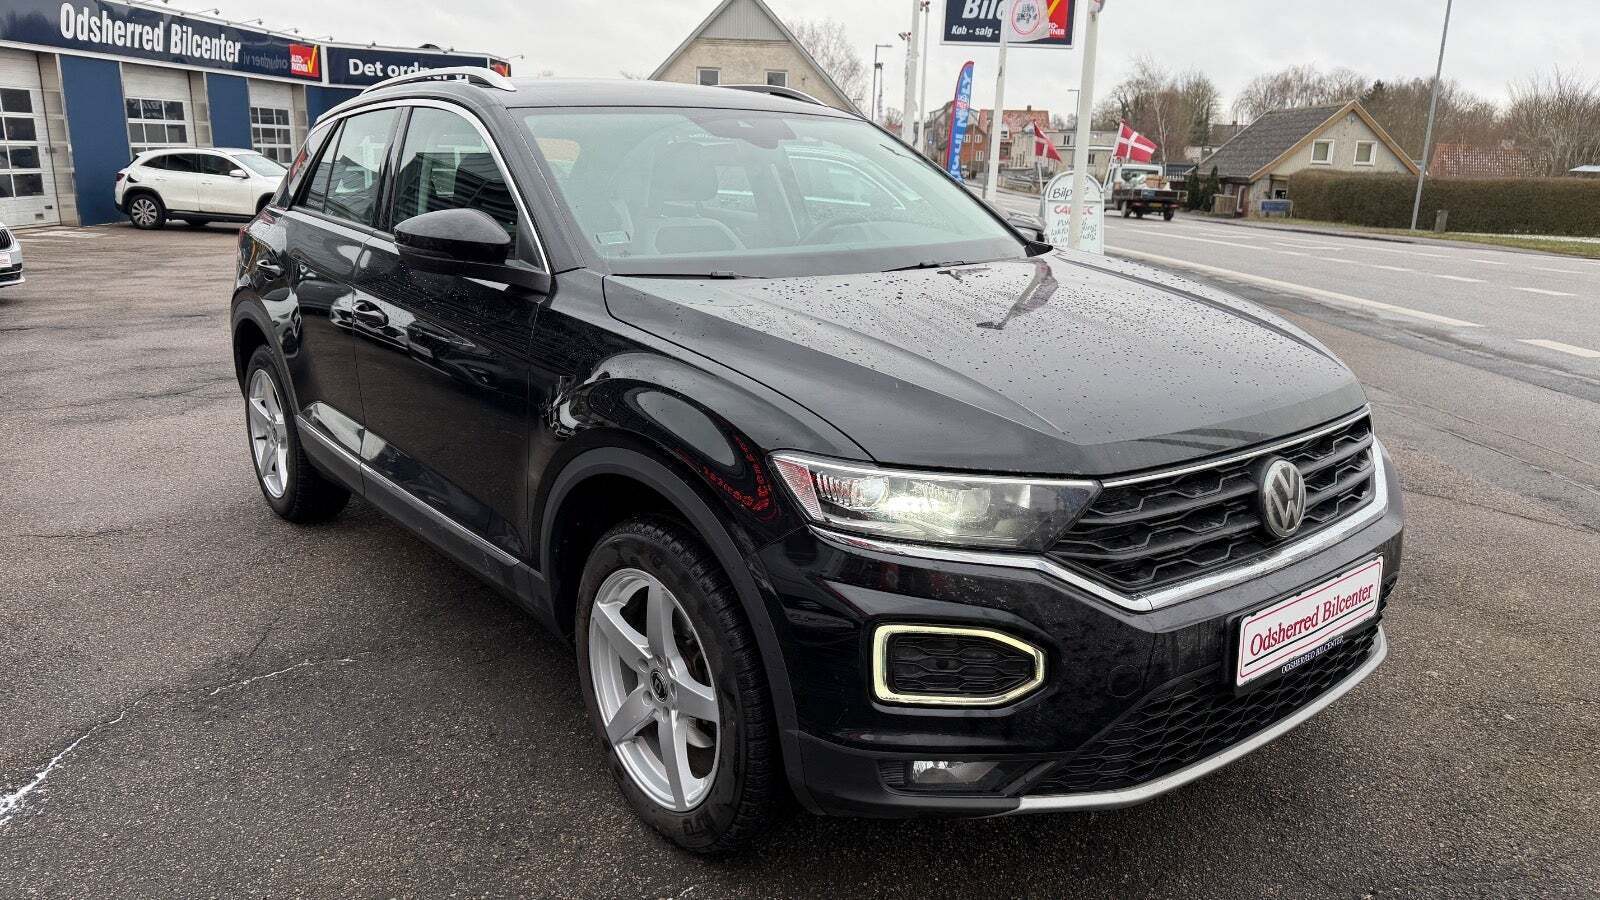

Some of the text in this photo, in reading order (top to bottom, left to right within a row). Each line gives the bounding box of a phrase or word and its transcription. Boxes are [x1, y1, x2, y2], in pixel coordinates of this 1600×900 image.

[60, 2, 241, 63] Odsherred Bilcenter
[974, 26, 993, 38] salg
[348, 58, 384, 77] Det
[1250, 584, 1374, 656] Odsherred Bilcenter
